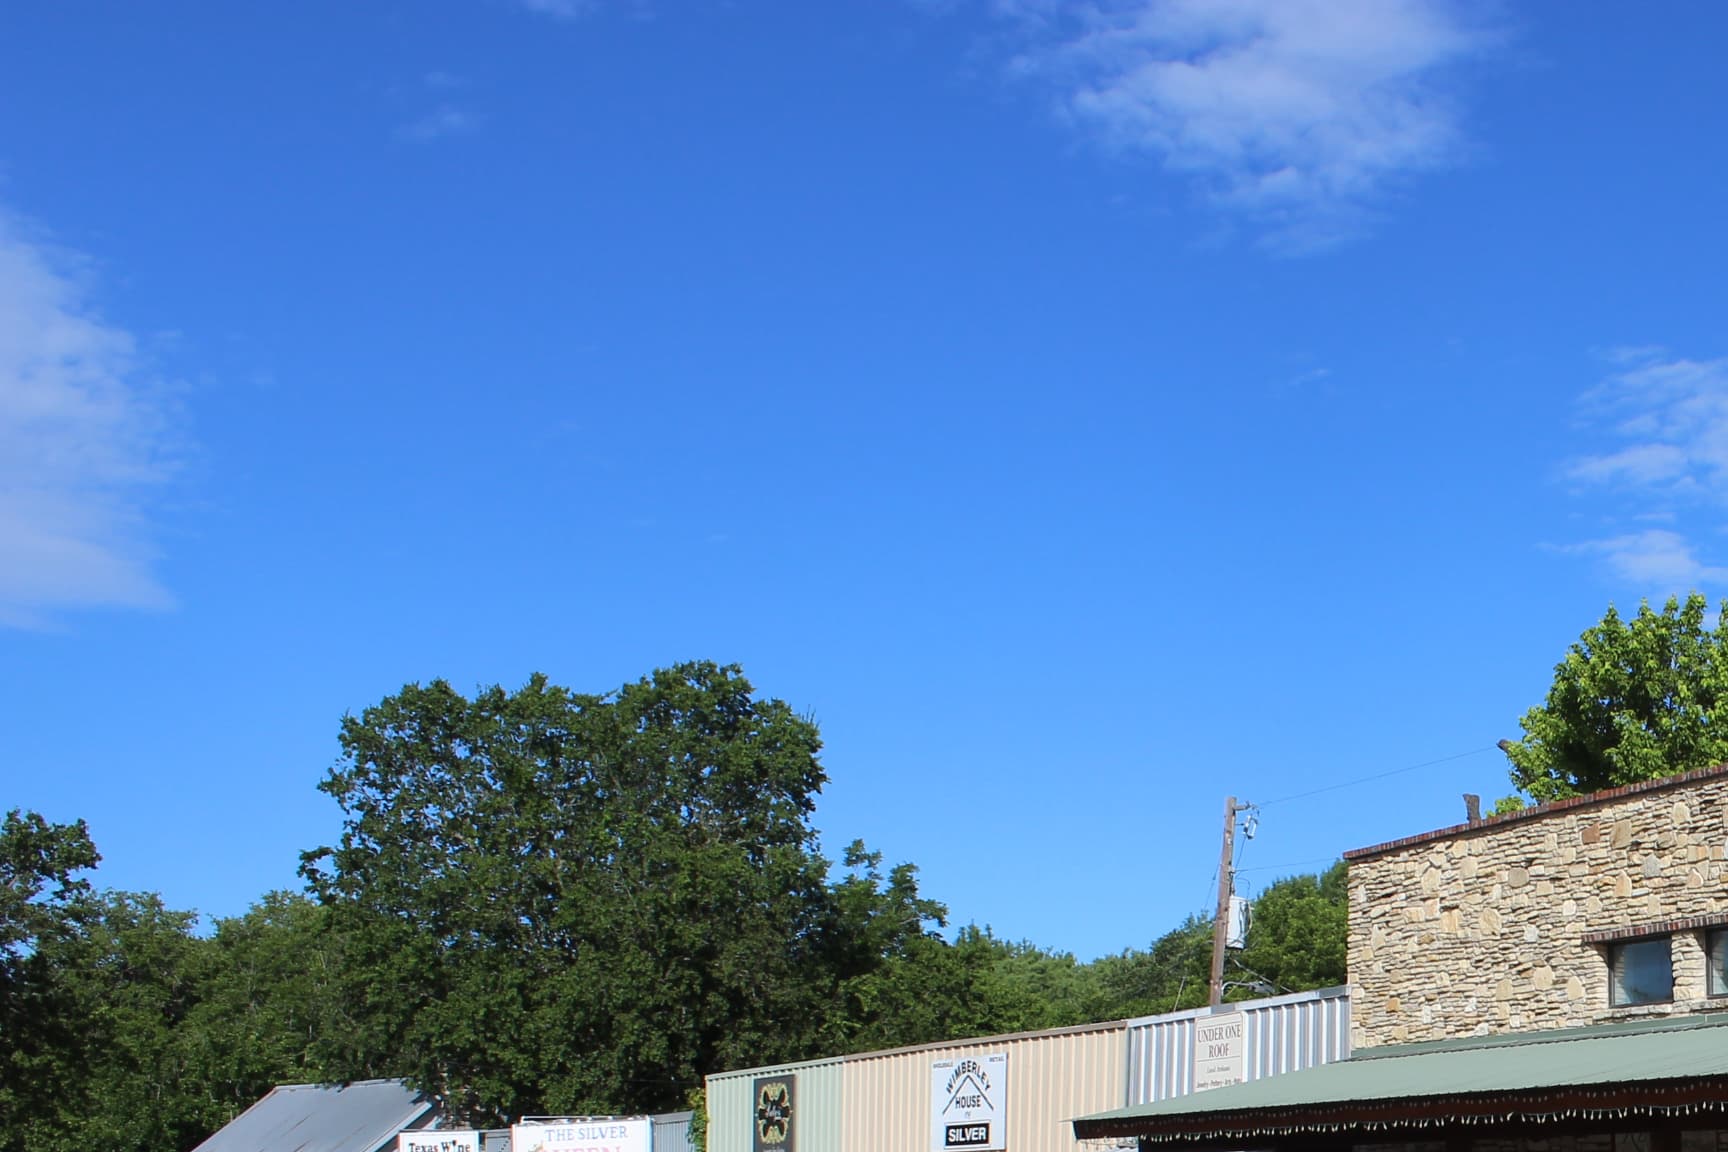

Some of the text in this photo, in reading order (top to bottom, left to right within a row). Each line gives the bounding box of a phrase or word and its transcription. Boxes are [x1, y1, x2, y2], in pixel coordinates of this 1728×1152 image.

[1197, 1024, 1241, 1043] UNDER ONE
[1208, 1043, 1230, 1058] ROOF
[946, 1060, 991, 1094] WIMBERLEY
[955, 1095, 981, 1109] HOUSE
[545, 1126, 629, 1142] THE SILVER
[948, 1127, 987, 1142] SILVER
